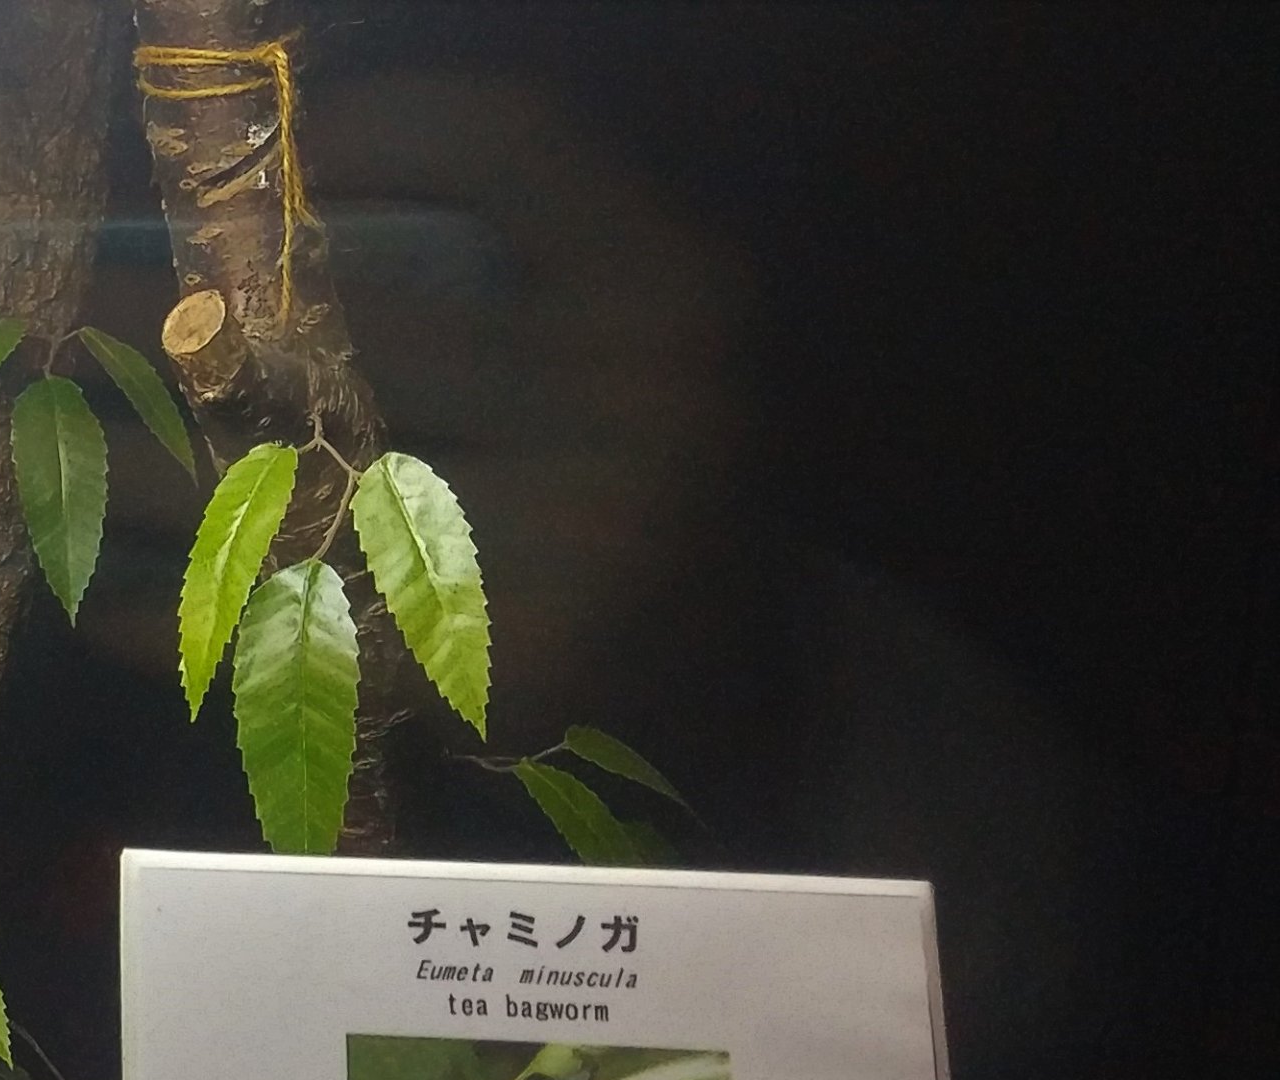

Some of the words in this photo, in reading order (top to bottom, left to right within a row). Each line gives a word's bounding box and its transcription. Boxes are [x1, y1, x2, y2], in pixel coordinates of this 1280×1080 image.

[408, 909, 639, 952] チャミノガ
[416, 960, 493, 983] Eumeta
[519, 965, 638, 988] minuscula
[448, 994, 488, 1017] tea
[506, 994, 610, 1022] bagworm
